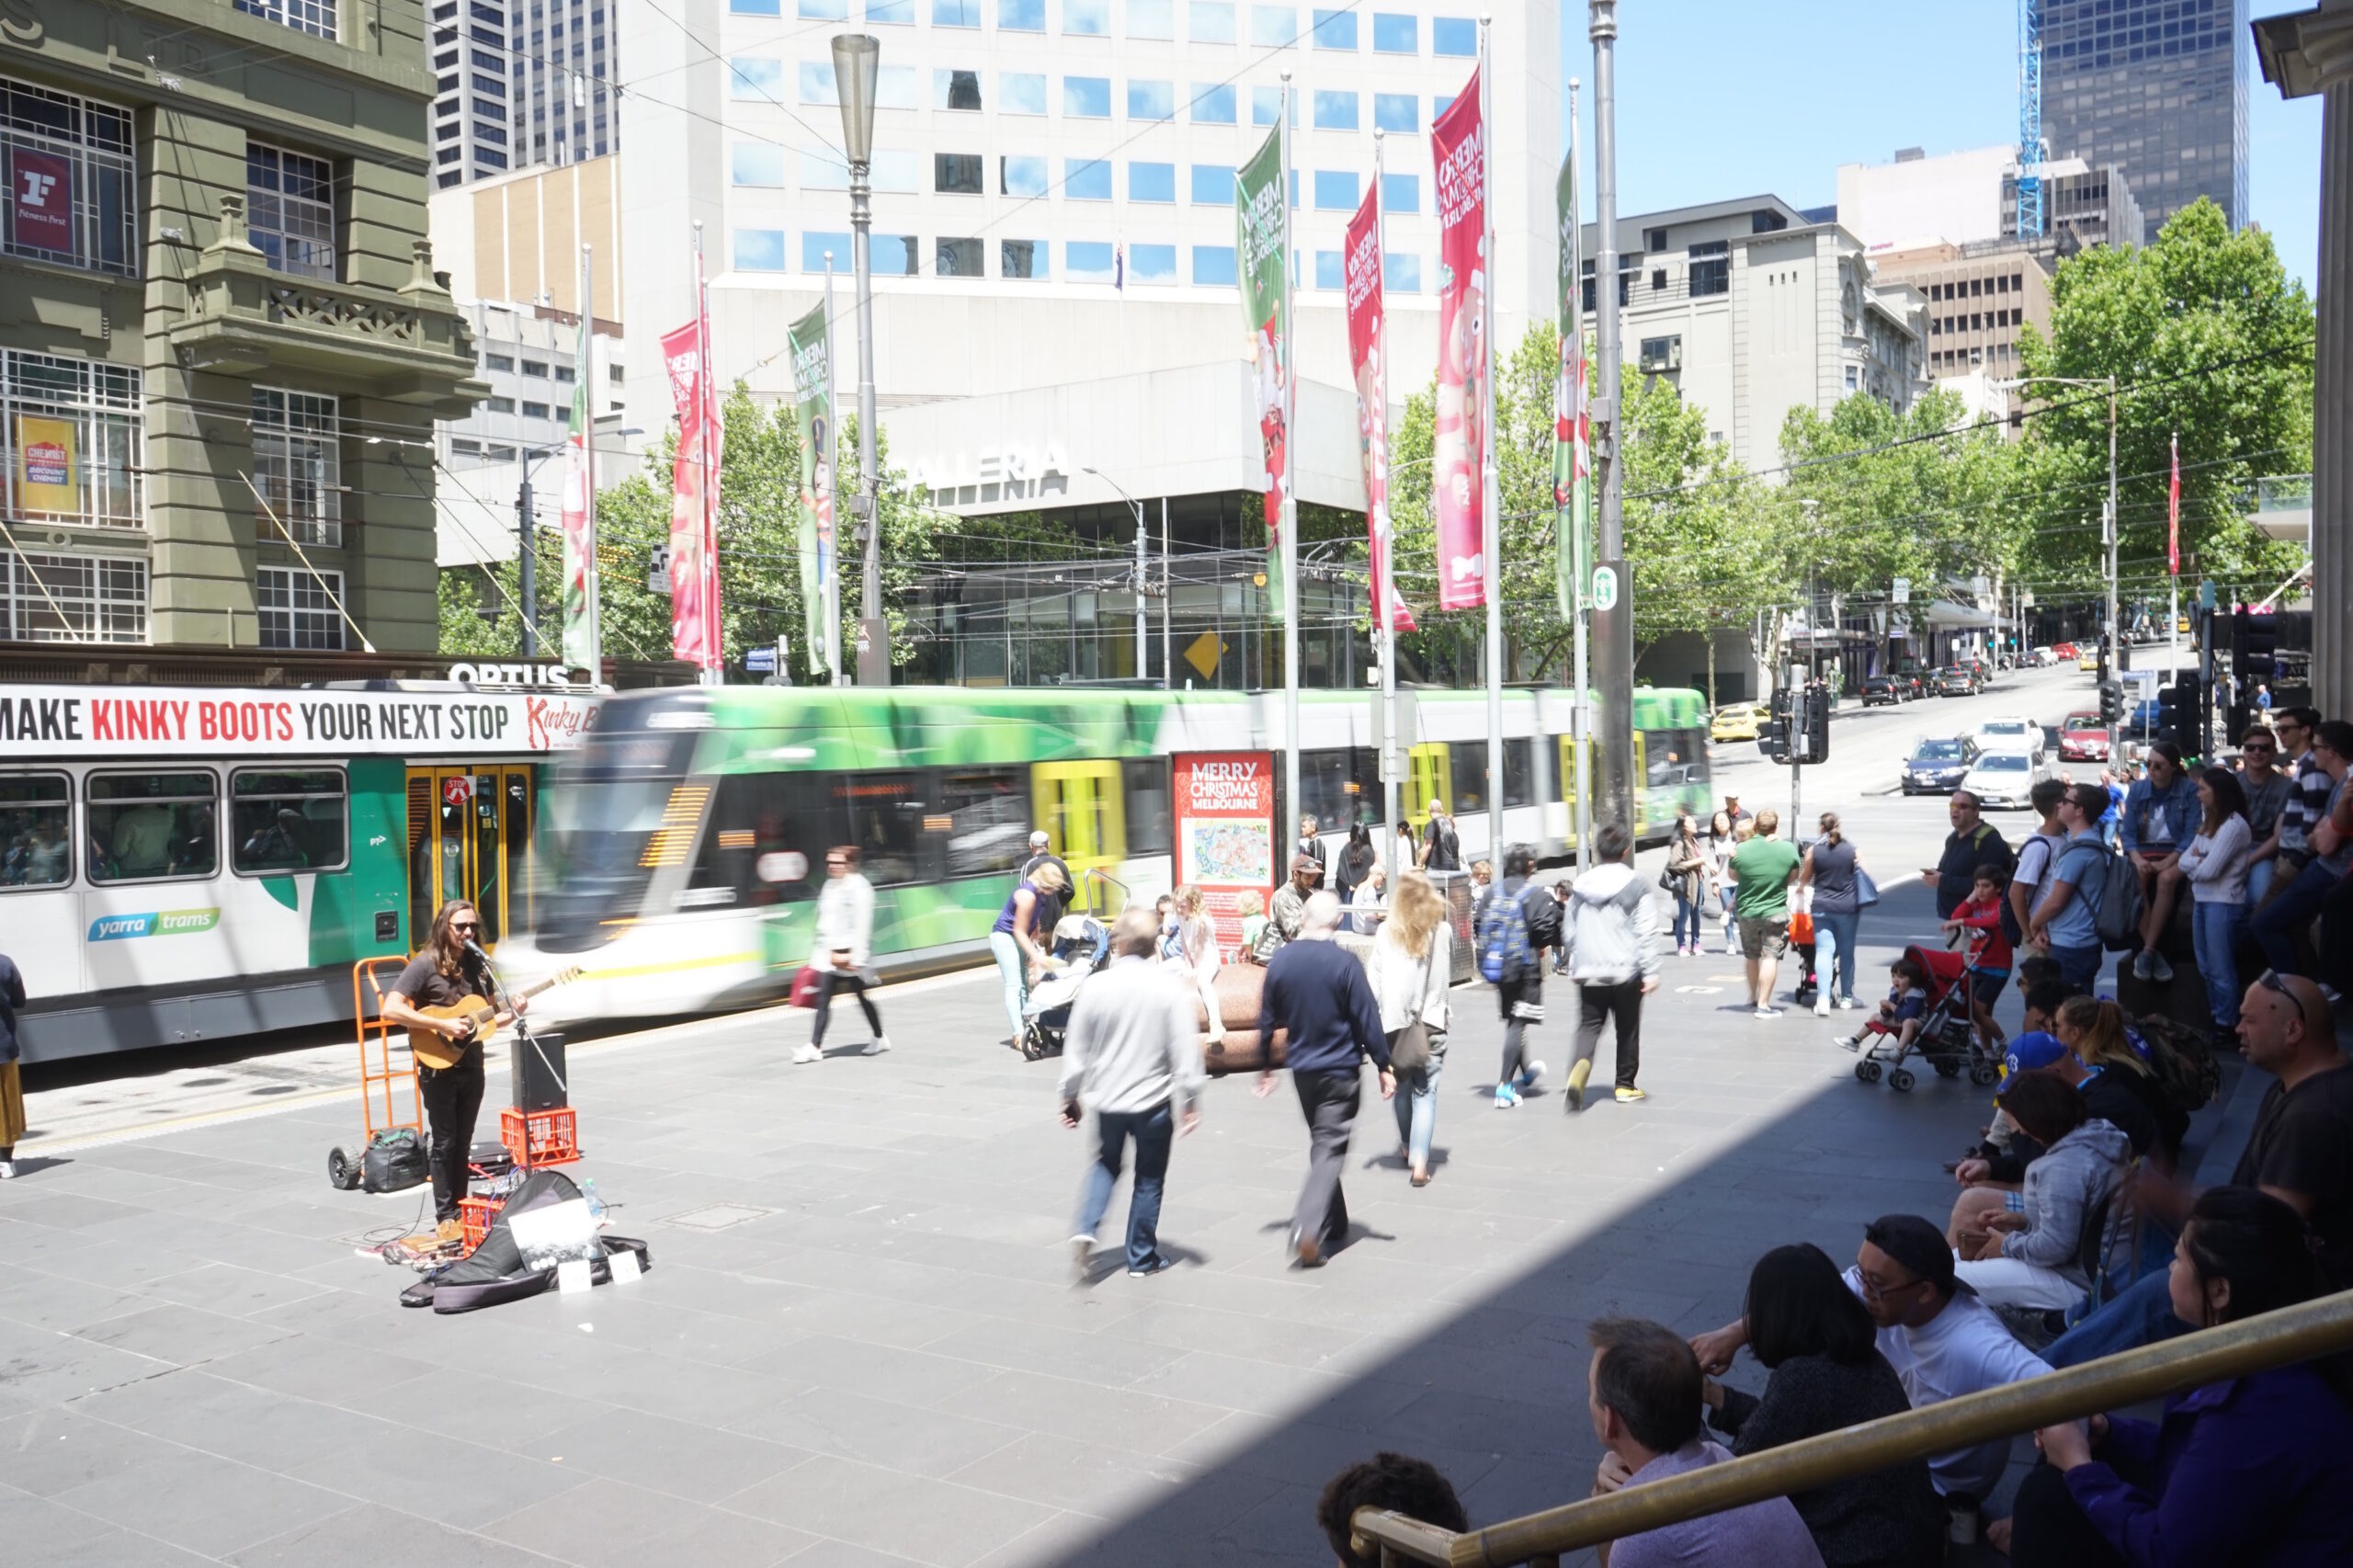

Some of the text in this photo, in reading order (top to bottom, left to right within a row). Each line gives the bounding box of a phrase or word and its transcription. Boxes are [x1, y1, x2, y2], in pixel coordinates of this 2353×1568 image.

[18, 209, 66, 226] Fitness First
[28, 448, 65, 460] CHEMIST
[91, 699, 189, 741] KINKY
[199, 701, 294, 742] BOOTS
[301, 702, 373, 741] YOUR
[380, 704, 442, 740] NEXT
[449, 704, 508, 741] STOP
[526, 696, 581, 751] Kinky
[1192, 762, 1257, 781] MERRY
[449, 779, 467, 789] STOP
[1190, 781, 1257, 799] CHRISTMAS
[1193, 799, 1257, 810] MELBOURNE
[98, 914, 210, 937] yarra trams
